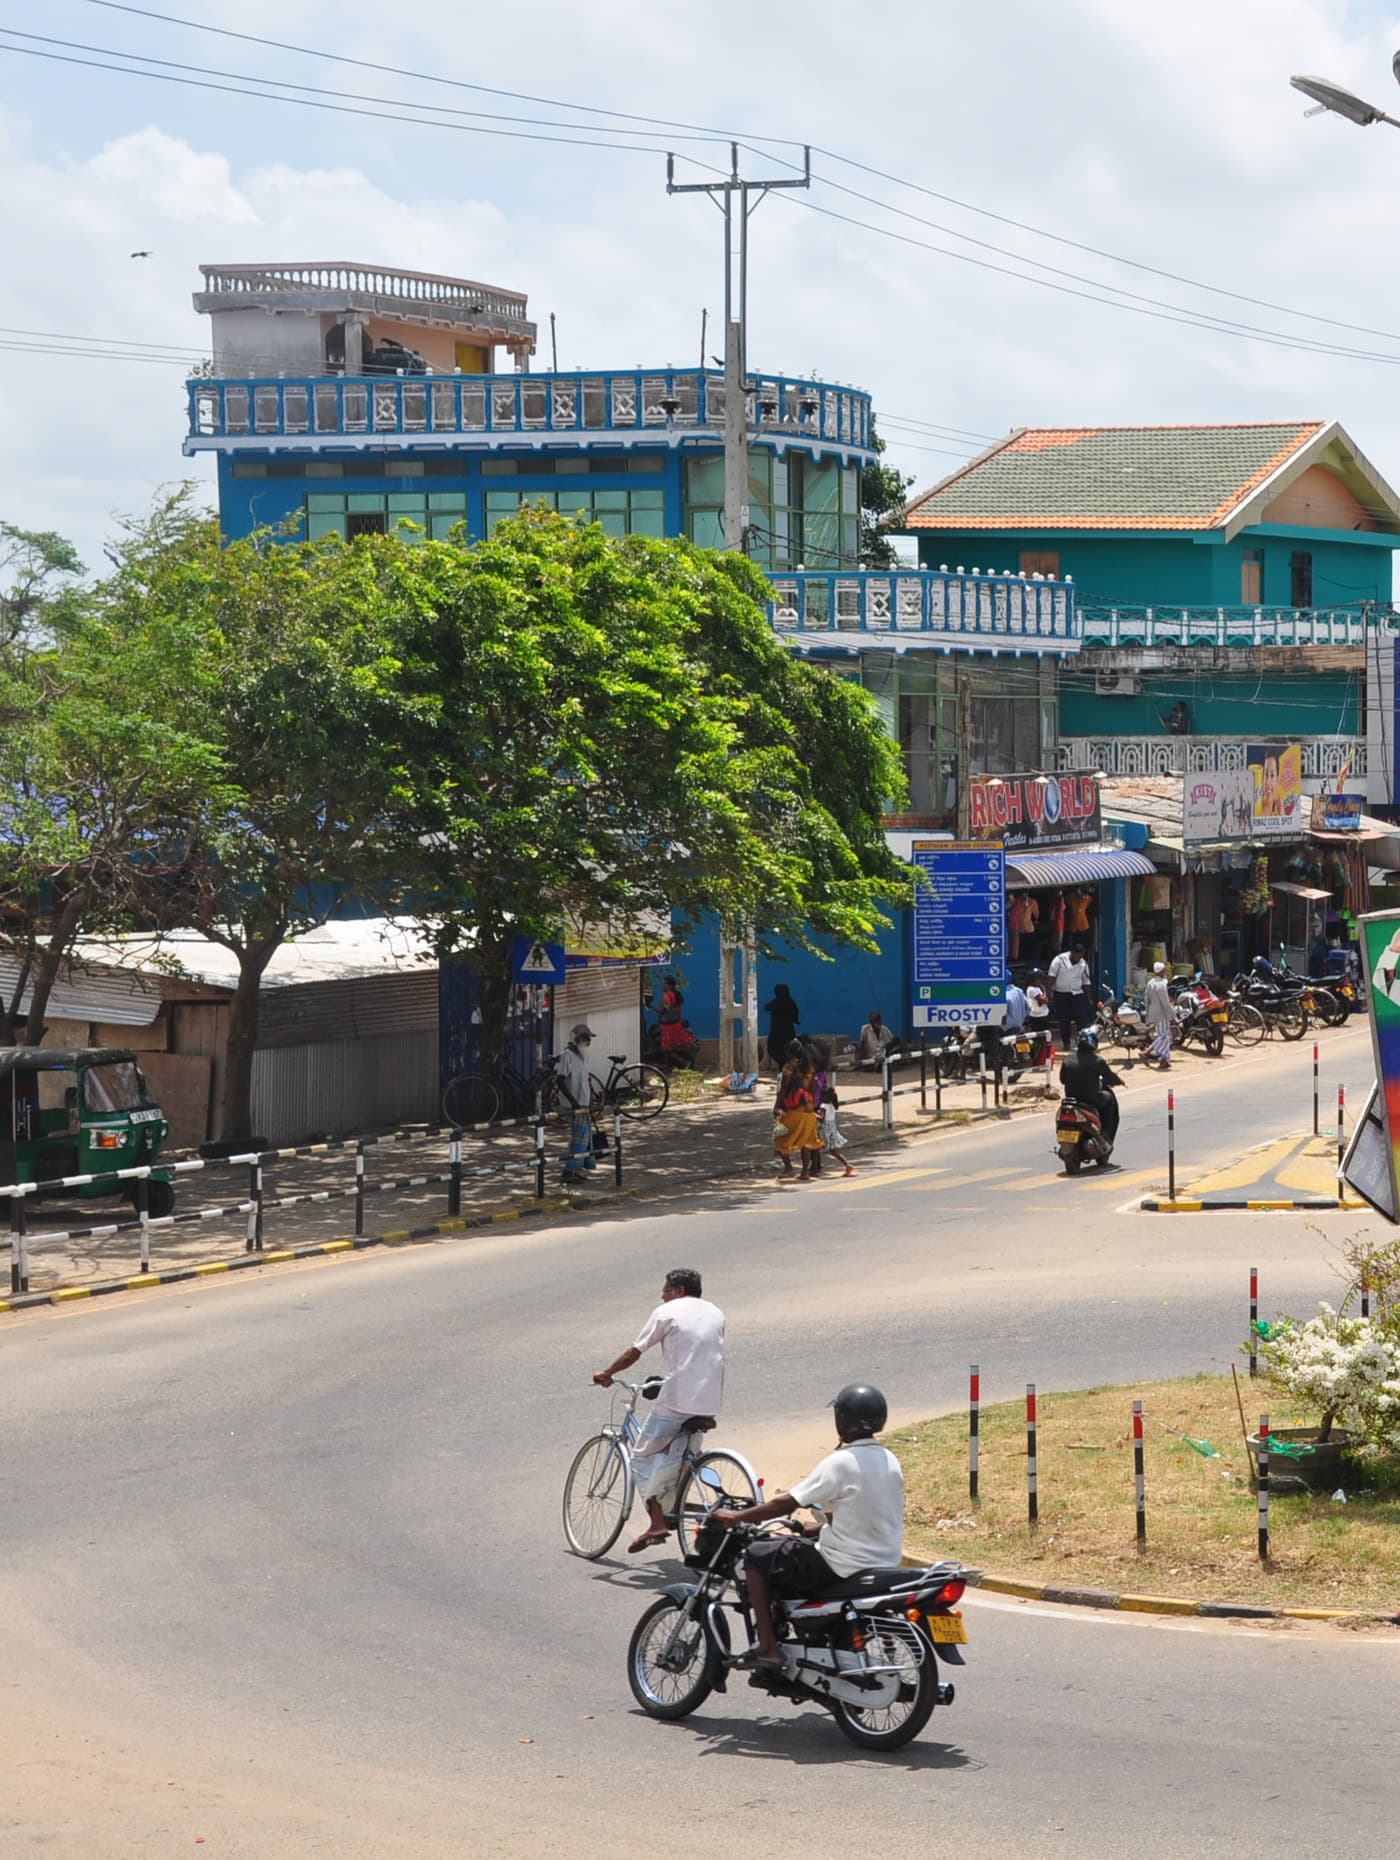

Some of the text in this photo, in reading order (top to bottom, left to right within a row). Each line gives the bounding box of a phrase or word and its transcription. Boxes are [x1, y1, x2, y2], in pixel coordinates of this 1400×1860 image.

[971, 776, 1096, 828] RICH WORLD
[922, 988, 930, 997] P
[927, 1006, 992, 1023] FROSTY
